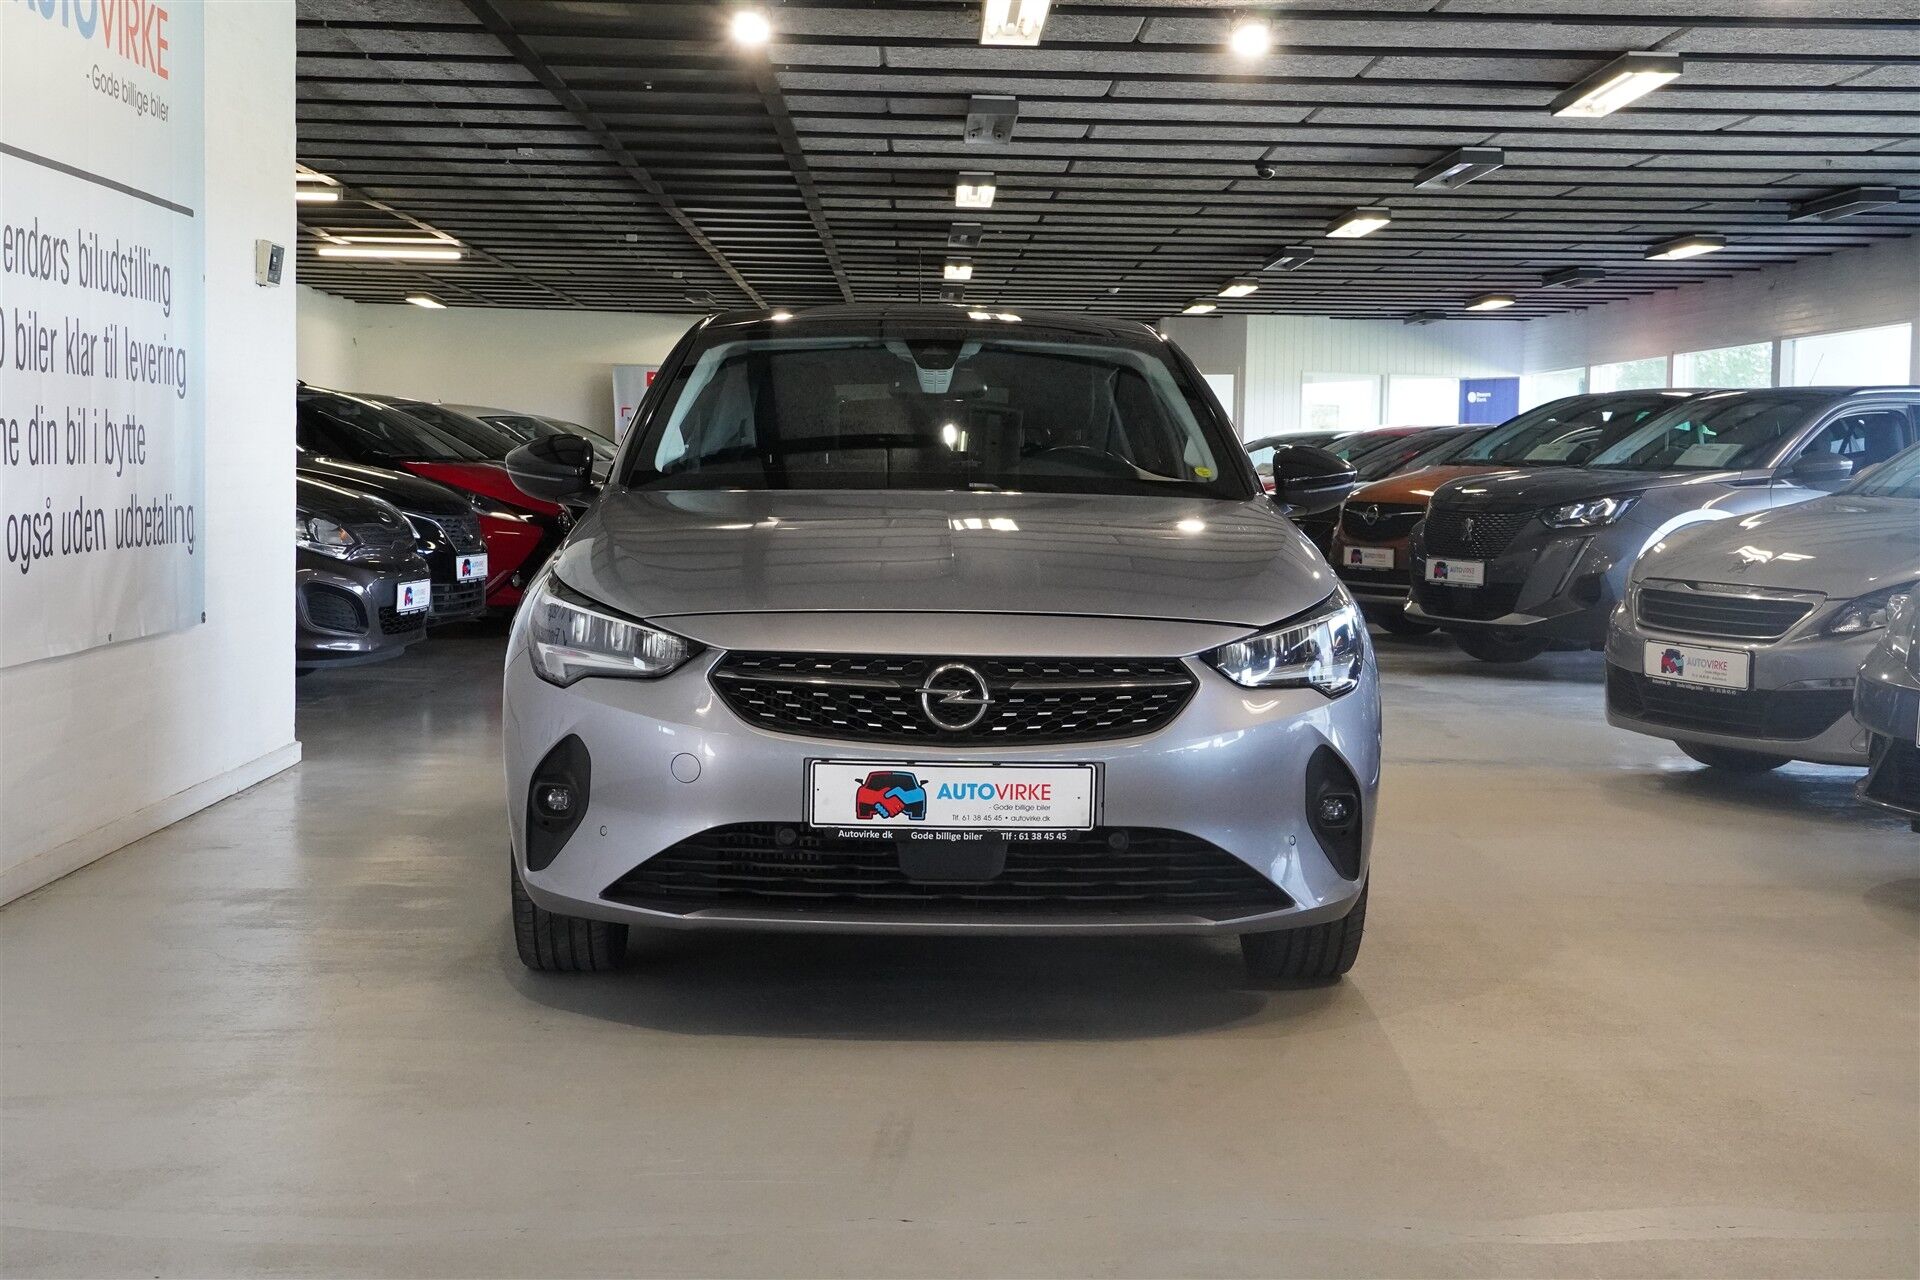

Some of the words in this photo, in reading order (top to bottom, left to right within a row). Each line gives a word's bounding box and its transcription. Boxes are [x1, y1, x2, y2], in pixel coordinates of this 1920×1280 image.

[14, 0, 168, 80] OVIRKE
[92, 64, 120, 100] Gode
[121, 77, 149, 117] billige
[150, 92, 169, 123] biler
[3, 216, 70, 286] endørs
[78, 228, 171, 318] biludstilling
[15, 307, 57, 374] biler
[65, 316, 98, 377] klar
[103, 323, 118, 380] til
[124, 326, 187, 400] levering
[28, 404, 58, 466] din
[66, 406, 86, 466] bil
[94, 408, 97, 465] i
[104, 408, 146, 478] bytte
[6, 496, 54, 575] også
[61, 495, 107, 556] uden
[115, 493, 194, 556] udbetaling
[1687, 656, 1728, 671] AUTOVIRKE
[936, 783, 1052, 801] AUTOVIRKE
[972, 814, 982, 822] 38
[983, 814, 993, 822] 45
[993, 814, 1003, 822] 45
[993, 803, 1013, 811] Gode
[1014, 803, 1035, 812] billige
[838, 829, 880, 839] Autovirke
[882, 830, 893, 839] dk
[910, 831, 934, 841] Gode
[935, 832, 961, 842] billige
[963, 832, 983, 841] biler
[1001, 832, 1012, 841] Tlf
[1018, 832, 1029, 841] 61
[1031, 832, 1042, 841] 38
[1043, 832, 1054, 841] 45
[1056, 832, 1067, 841] 45
